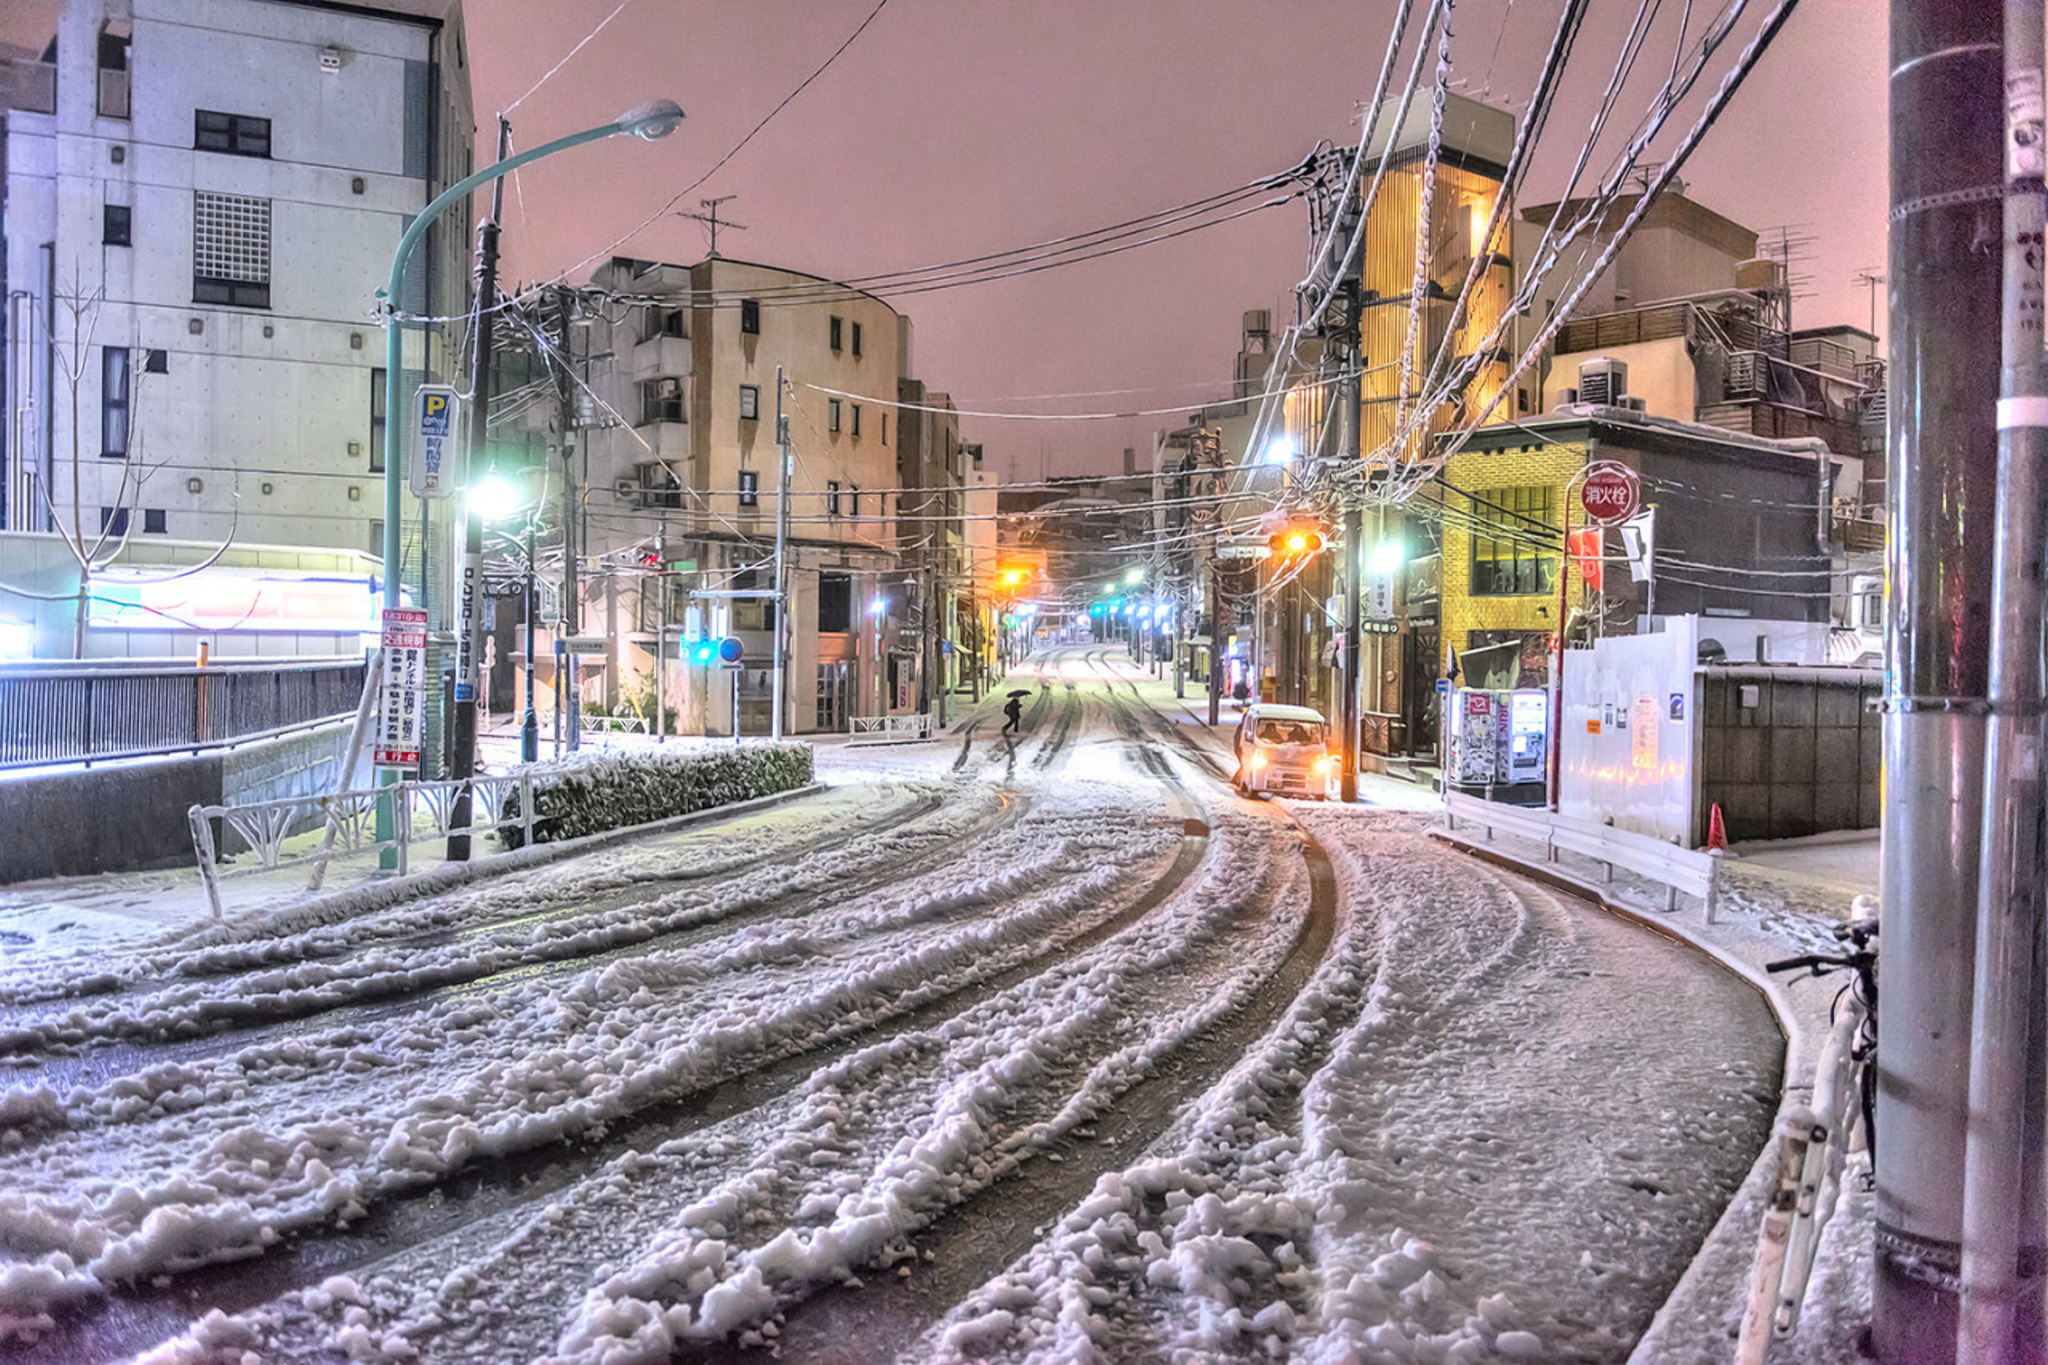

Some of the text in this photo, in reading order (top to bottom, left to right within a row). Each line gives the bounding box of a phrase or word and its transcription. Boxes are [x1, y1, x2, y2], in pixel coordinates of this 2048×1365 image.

[427, 396, 445, 416] P
[1585, 486, 1627, 505] 消火栓
